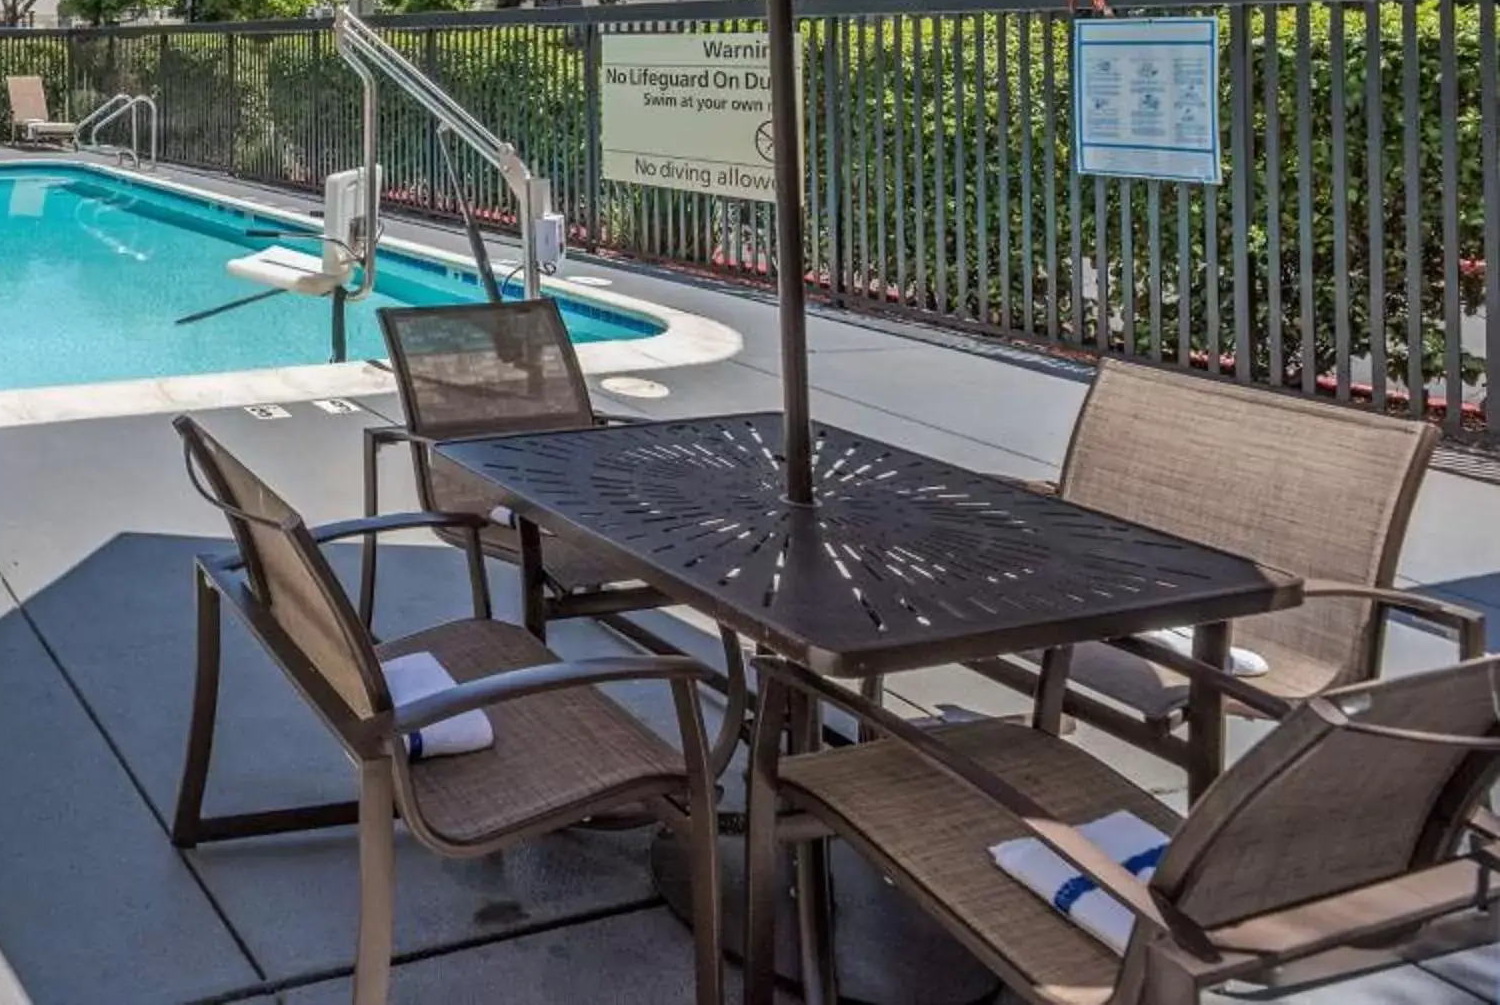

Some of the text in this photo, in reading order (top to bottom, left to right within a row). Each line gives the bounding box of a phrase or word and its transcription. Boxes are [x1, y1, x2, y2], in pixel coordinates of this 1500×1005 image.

[606, 68, 771, 91] No Lifeguard On Du
[644, 92, 677, 107] Swim
[680, 96, 693, 107] at
[697, 98, 728, 112] your
[731, 100, 763, 112] own
[635, 157, 775, 190] No diving allow
